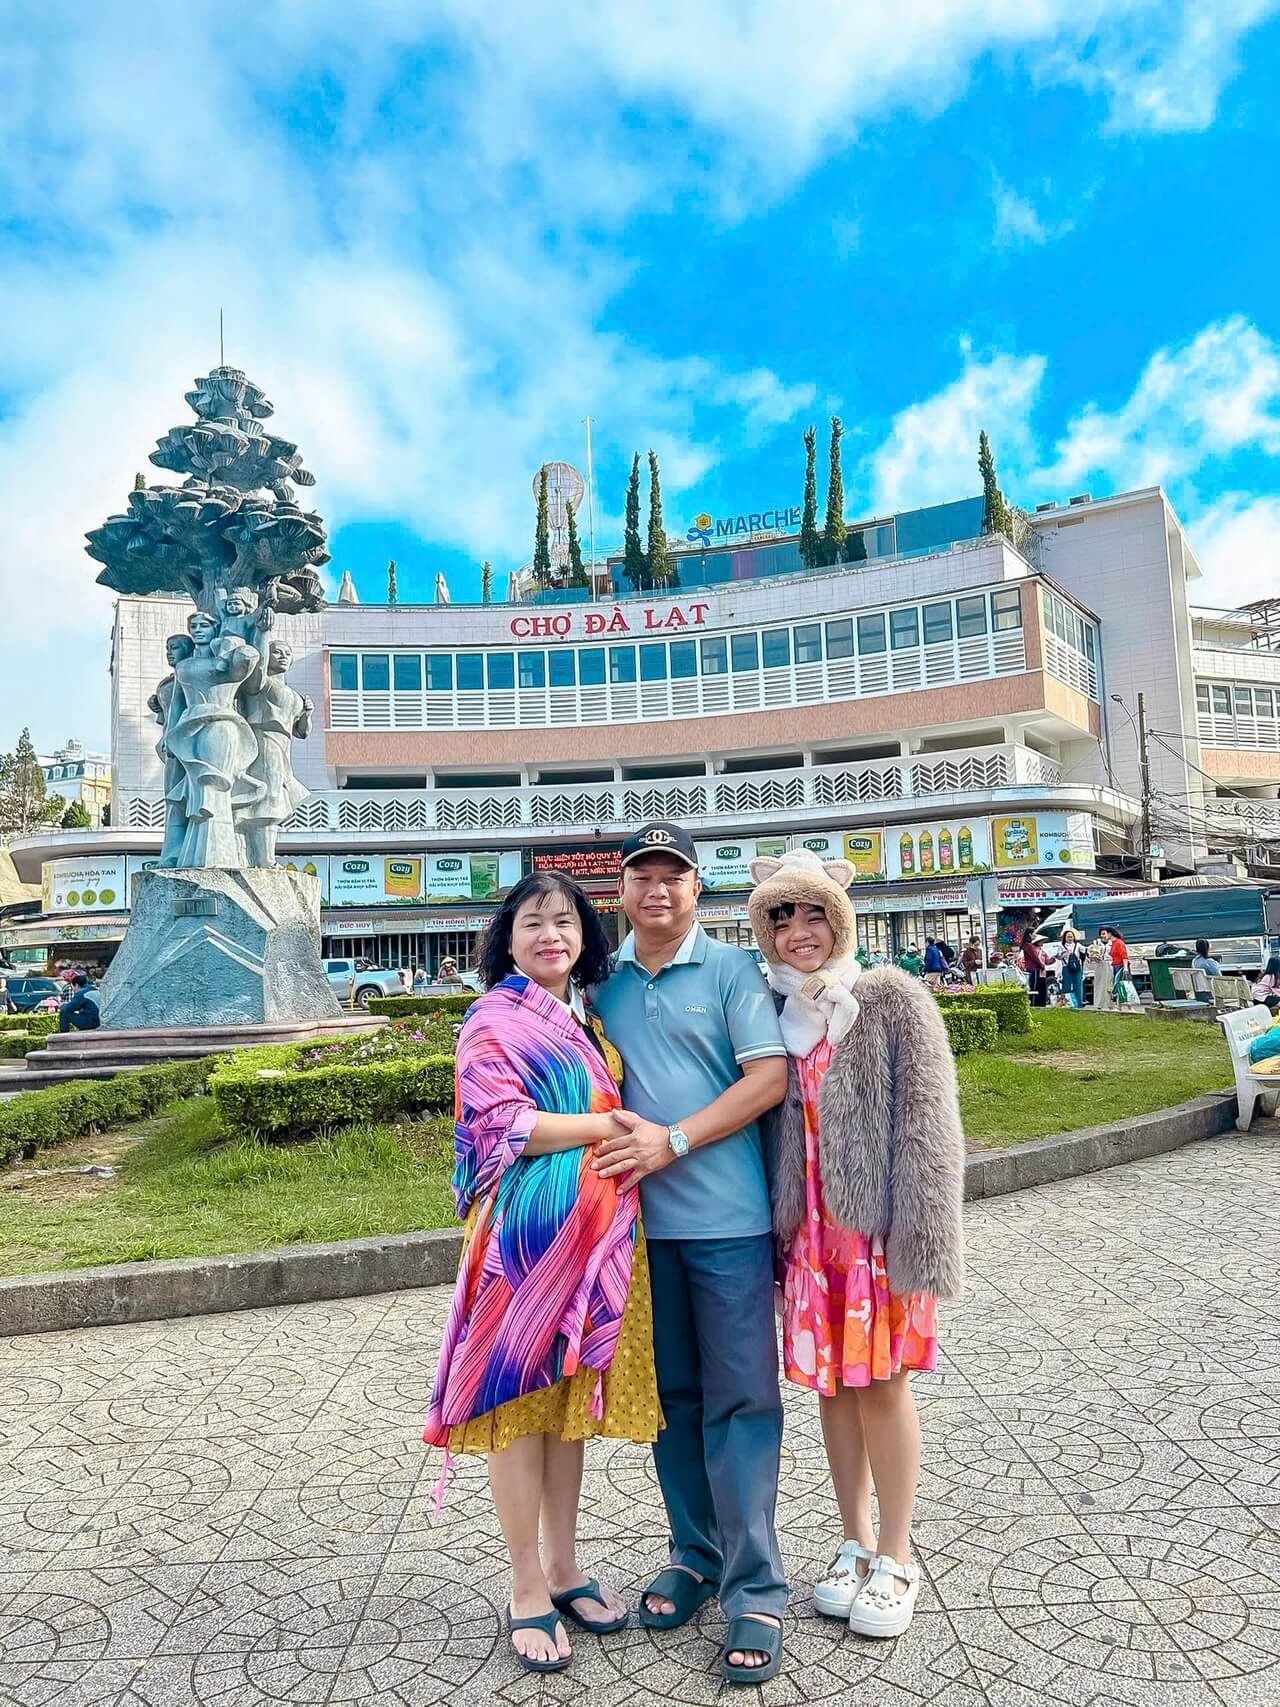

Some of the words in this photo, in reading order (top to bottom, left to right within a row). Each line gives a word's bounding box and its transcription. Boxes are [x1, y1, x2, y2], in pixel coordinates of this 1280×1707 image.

[510, 612, 572, 640] CHỢ
[584, 606, 630, 634] ĐÀ
[644, 603, 710, 631] LẠT
[804, 840, 826, 850] Cozy
[850, 839, 870, 849] Cozy
[571, 852, 585, 861] TỐT
[596, 852, 611, 860] QUY
[718, 848, 739, 858] Cozy
[345, 862, 367, 872] Cozy
[391, 864, 411, 874] Cozy
[438, 859, 460, 870] Cozy
[606, 866, 621, 874] KHÁ
[1053, 889, 1089, 897] TÂM
